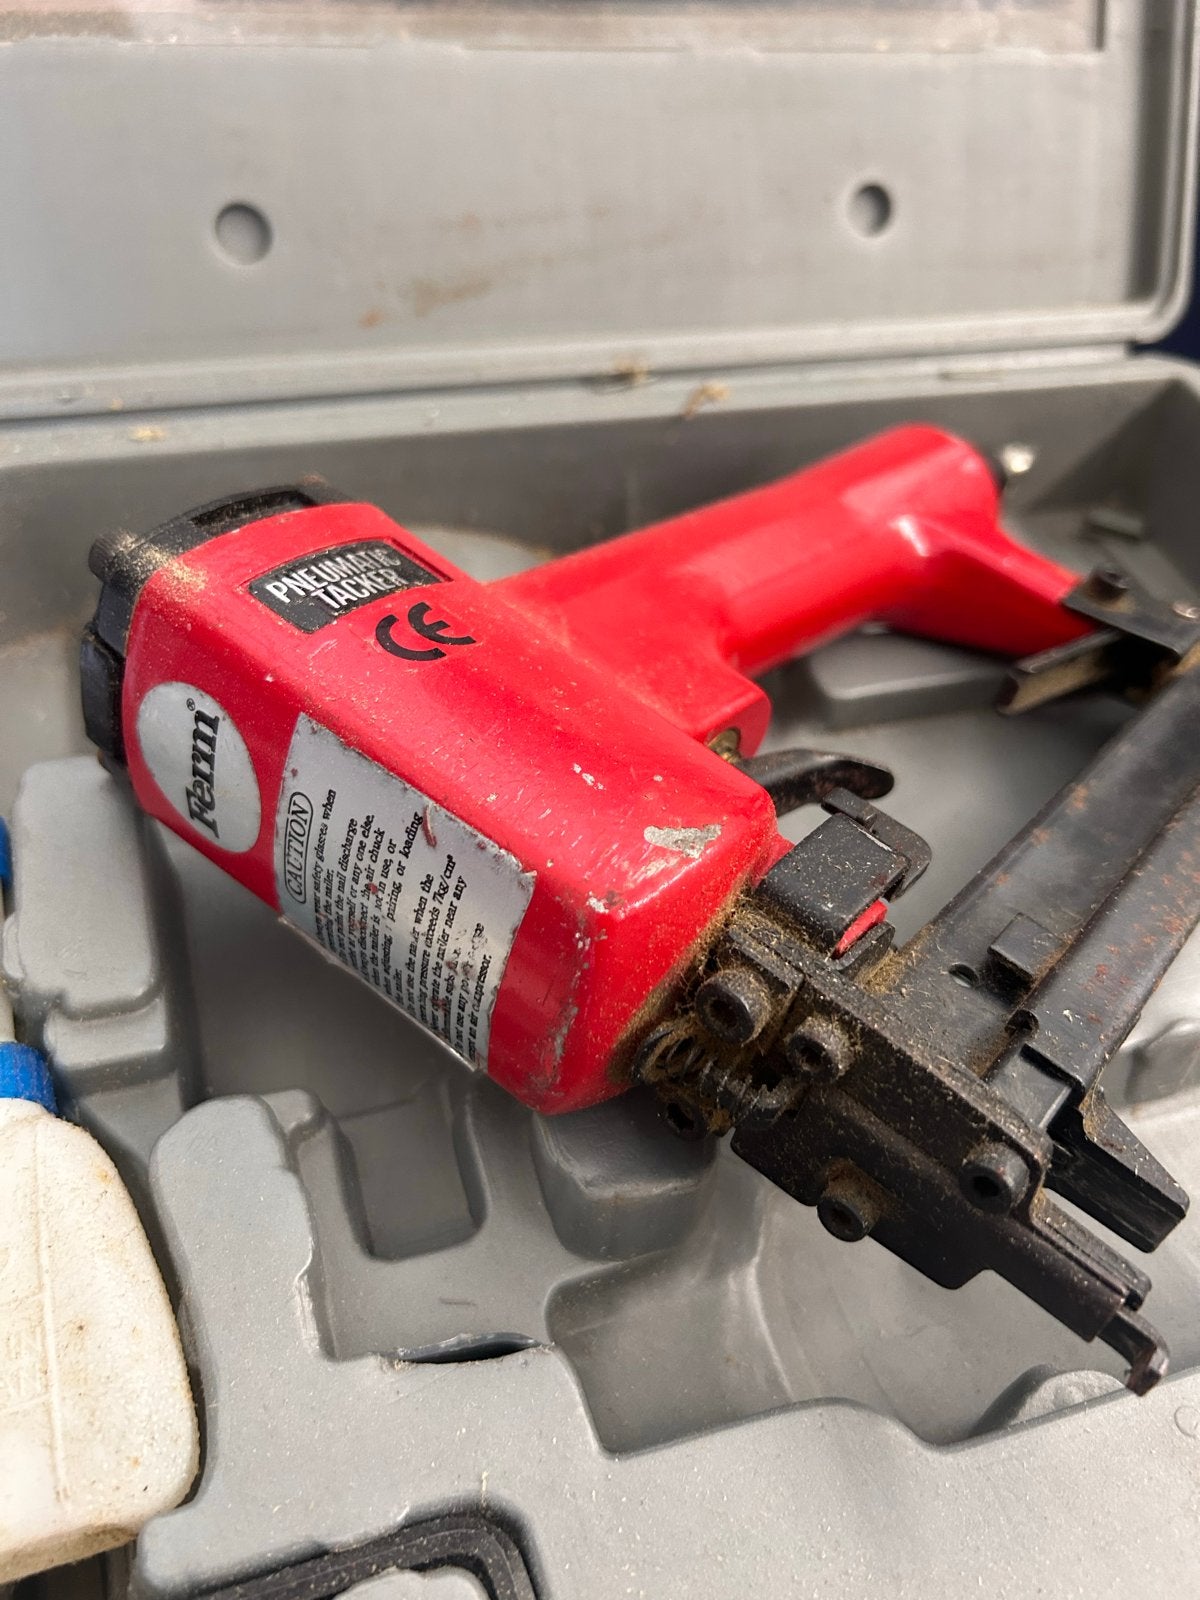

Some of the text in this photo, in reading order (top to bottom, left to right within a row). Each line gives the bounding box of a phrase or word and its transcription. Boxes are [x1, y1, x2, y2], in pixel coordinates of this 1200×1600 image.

[265, 548, 401, 603] PNEUMATIC
[310, 568, 408, 609] TACKER
[321, 787, 336, 821] when
[359, 813, 374, 839] else.
[398, 811, 423, 859] loading
[285, 797, 309, 897] CAUTION
[315, 821, 327, 863] glasses
[337, 816, 358, 872] discharge
[355, 838, 366, 862] one
[367, 825, 385, 863] chuck
[386, 837, 396, 854] or
[313, 859, 322, 893] safety
[351, 861, 363, 885] any
[364, 862, 374, 882] air
[380, 857, 393, 879] use,
[396, 860, 405, 876] or
[324, 867, 333, 899] nailer.
[337, 870, 346, 894] nail
[350, 884, 357, 898] or
[376, 880, 385, 894] in
[419, 872, 434, 894] the
[452, 875, 467, 900] any
[323, 898, 331, 915] the
[334, 893, 343, 911] the
[385, 880, 401, 932] pairing,
[413, 894, 427, 925] when
[444, 899, 457, 928] near
[371, 912, 379, 924] is
[424, 905, 440, 949] exceeds
[409, 926, 419, 956] naer
[435, 927, 449, 960] nailer
[405, 955, 414, 973] the
[420, 948, 429, 989] pressure
[431, 960, 442, 977] the
[457, 993, 467, 1012] any
[456, 1011, 464, 1028] use
